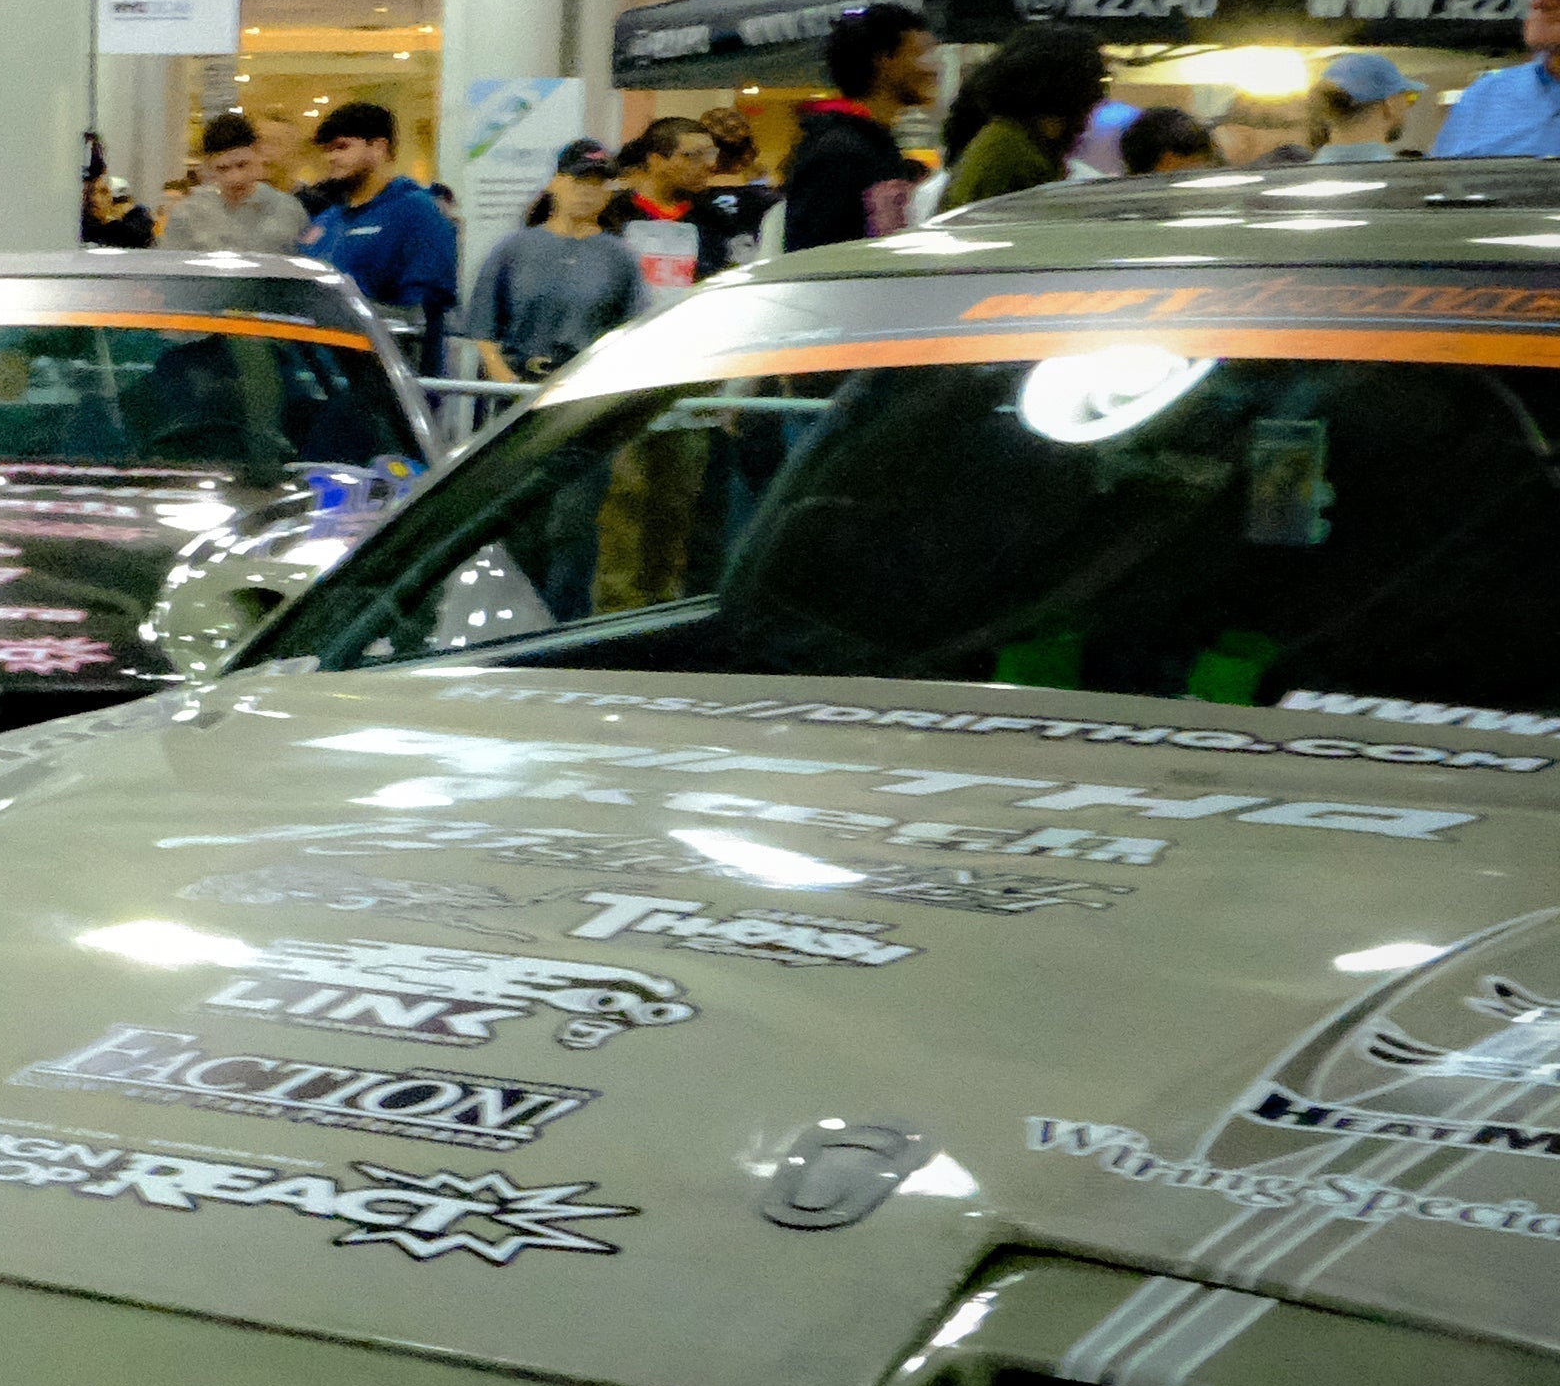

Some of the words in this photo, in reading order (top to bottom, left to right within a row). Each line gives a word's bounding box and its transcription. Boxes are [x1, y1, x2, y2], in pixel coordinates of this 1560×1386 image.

[436, 682, 1555, 773] HTTPS://DRIFTHQ.COM
[204, 976, 529, 1040] LINK
[58, 1023, 586, 1133] FACTION
[84, 1151, 506, 1235] REACT
[1024, 1115, 1298, 1209] Wiring
